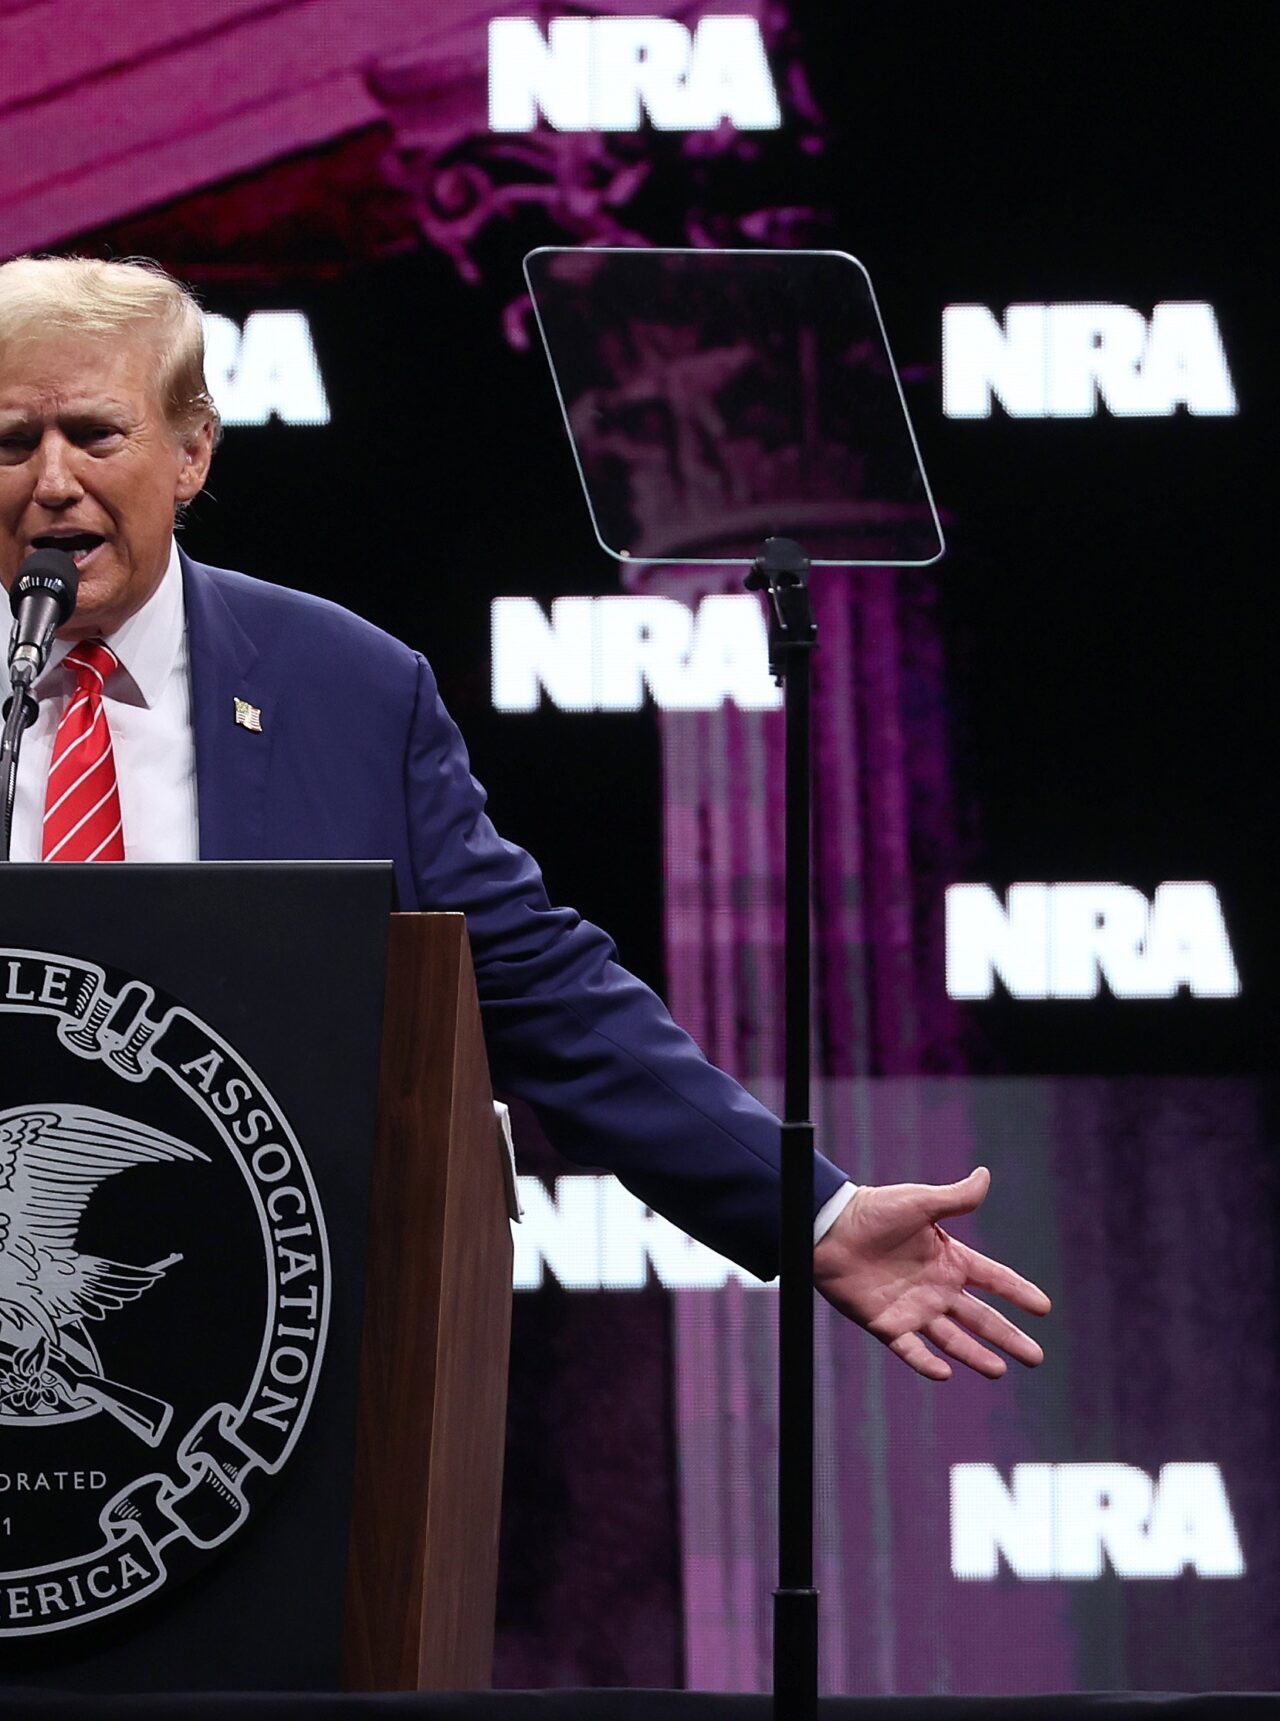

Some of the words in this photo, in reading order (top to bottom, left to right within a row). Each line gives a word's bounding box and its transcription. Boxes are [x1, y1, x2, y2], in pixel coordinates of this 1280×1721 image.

[488, 15, 781, 132] NRA
[942, 303, 1237, 419] NRA
[491, 594, 784, 713] NRA
[945, 881, 1239, 999] NRA
[181, 1046, 320, 1434] ASSOCIATION
[950, 1462, 1244, 1580] NRA
